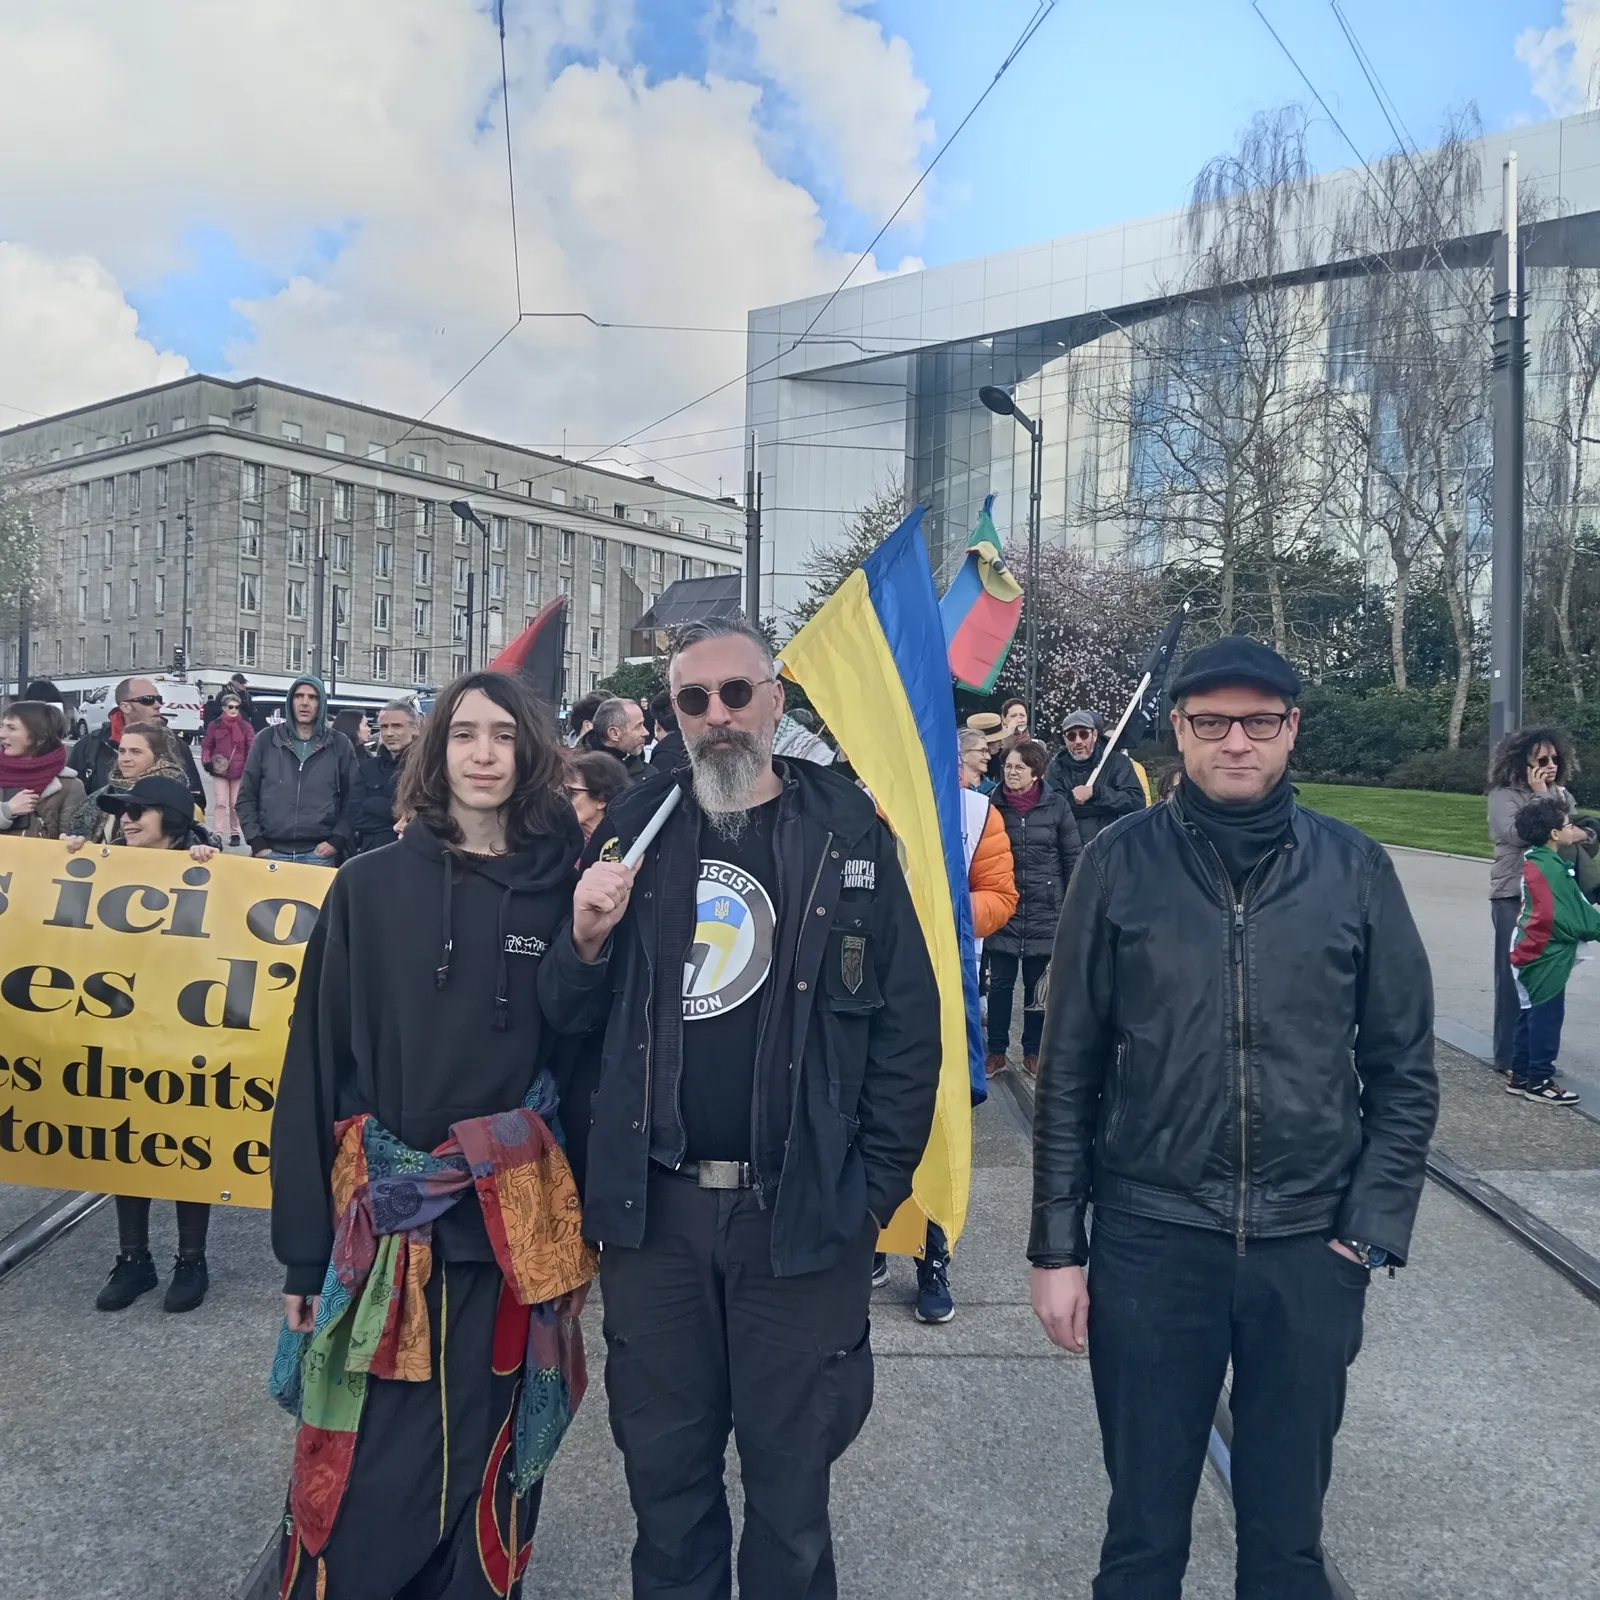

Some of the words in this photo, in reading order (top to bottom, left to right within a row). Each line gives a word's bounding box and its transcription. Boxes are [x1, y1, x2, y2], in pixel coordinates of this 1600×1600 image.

[43, 857, 211, 938] ici
[841, 859, 876, 878] ROPIA
[843, 874, 875, 890] MORTE
[177, 957, 298, 1031] d’
[0, 1054, 42, 1091] s
[62, 1045, 275, 1112] droits
[0, 1105, 212, 1171] toutes
